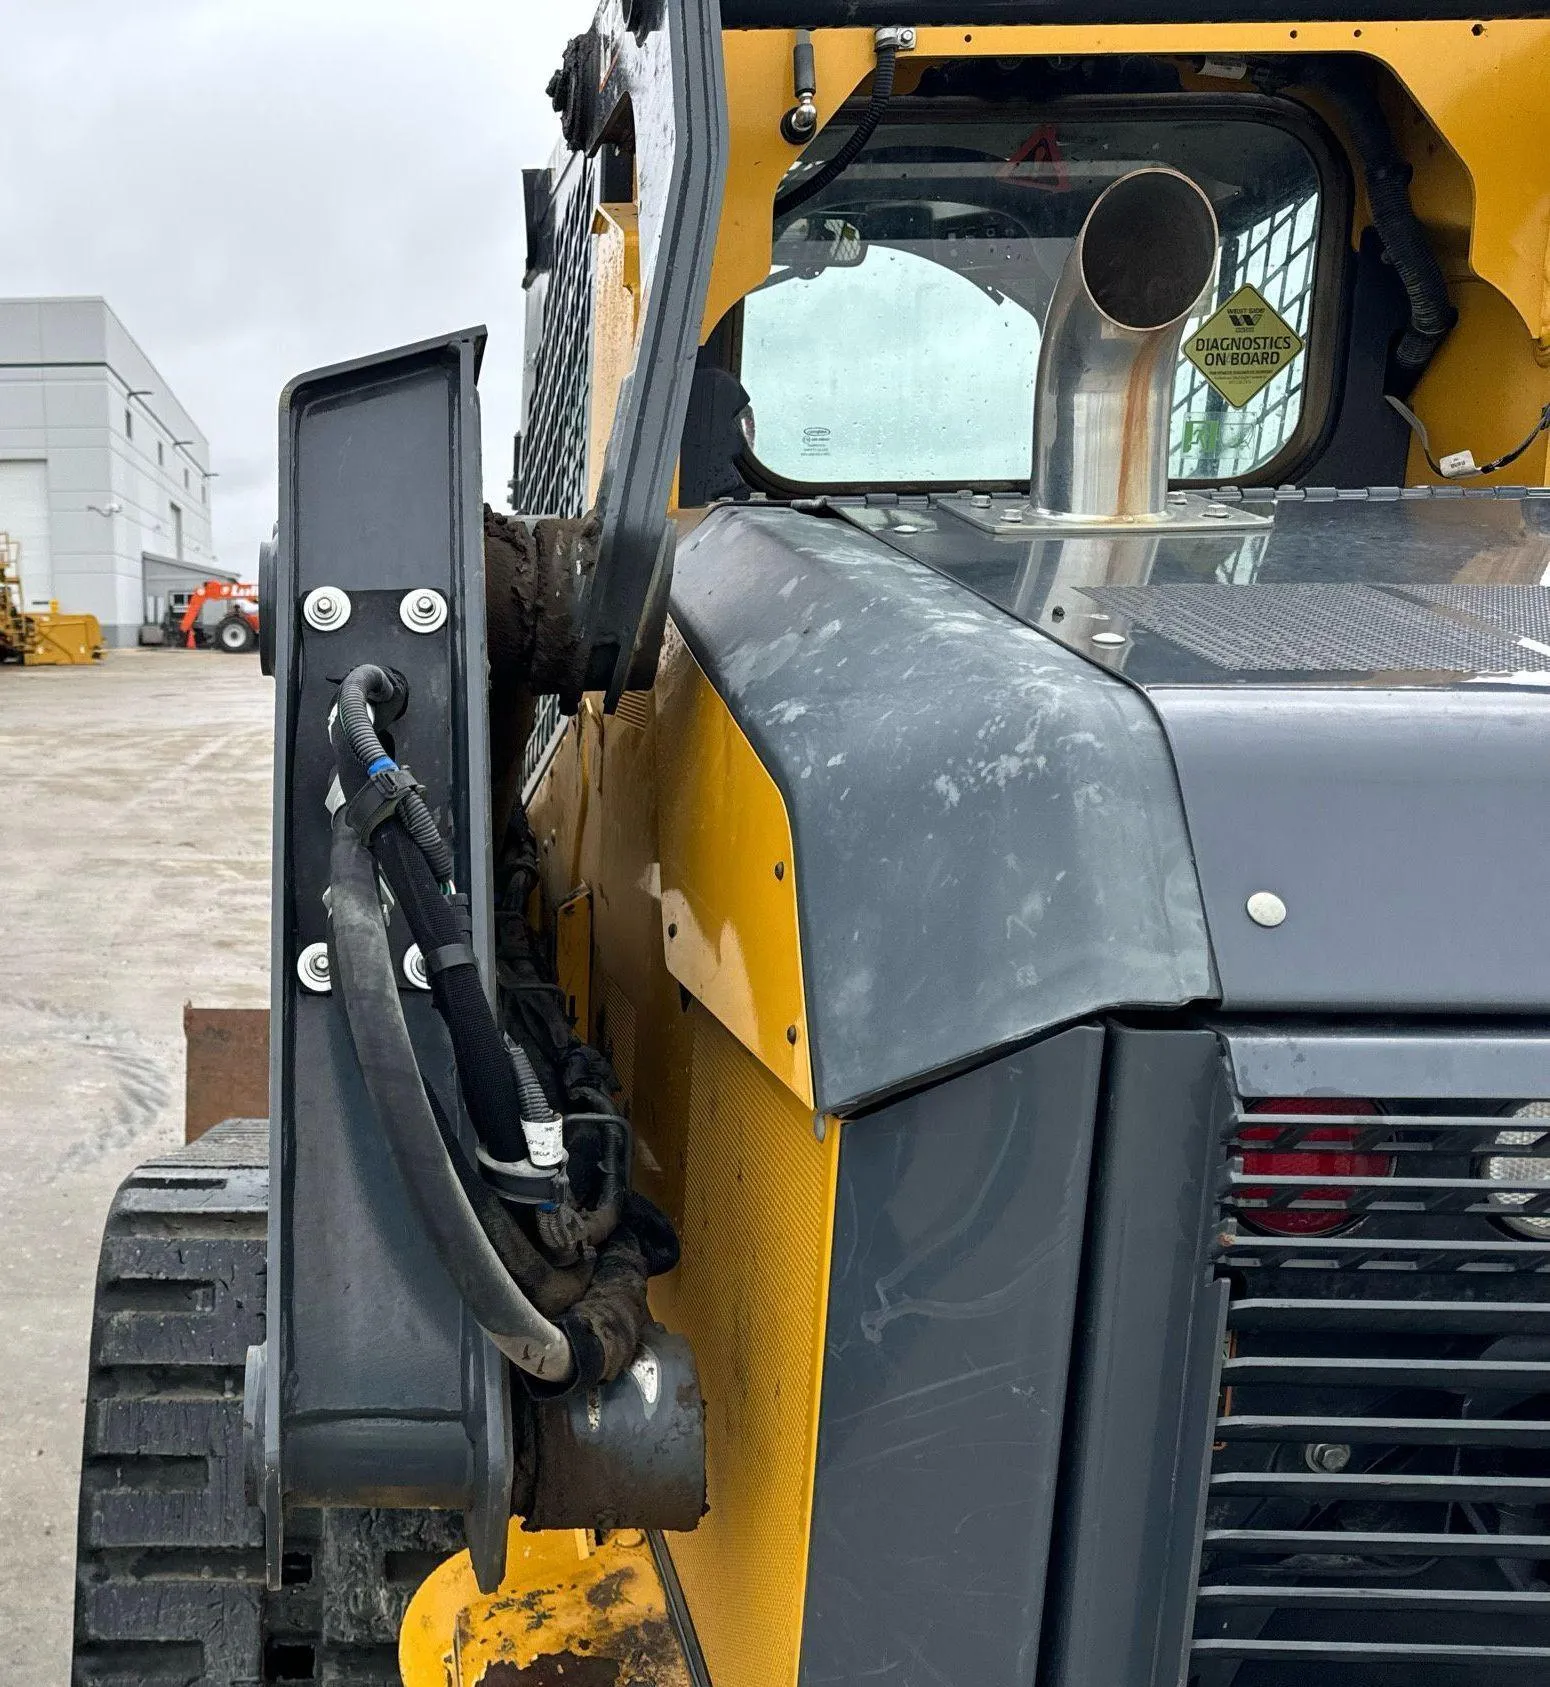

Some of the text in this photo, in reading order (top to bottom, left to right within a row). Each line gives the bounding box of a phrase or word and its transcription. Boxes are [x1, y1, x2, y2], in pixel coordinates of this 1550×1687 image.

[1195, 336, 1291, 351] DIAGNOSTICS
[1204, 351, 1280, 366] ON BOARD
